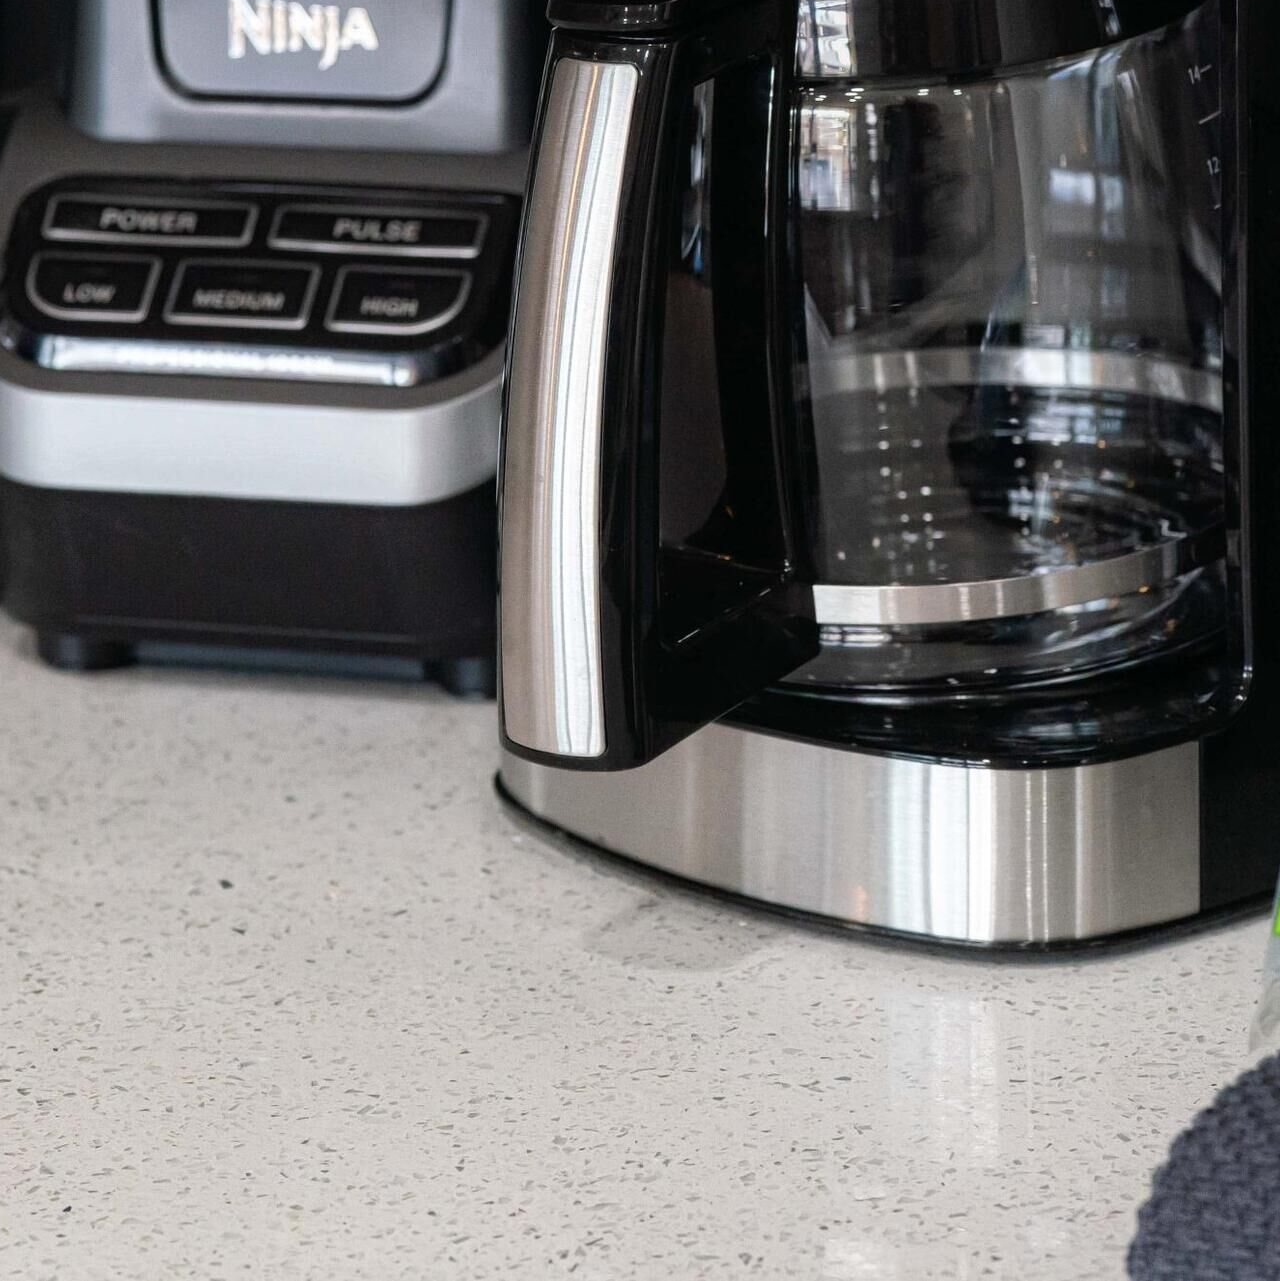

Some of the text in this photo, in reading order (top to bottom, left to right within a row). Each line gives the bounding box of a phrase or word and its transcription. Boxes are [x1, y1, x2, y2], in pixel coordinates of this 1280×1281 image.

[1188, 64, 1201, 85] 14
[99, 207, 198, 234] POWER
[333, 219, 421, 242] PULSE
[63, 283, 116, 305] LOW
[193, 289, 285, 312] MEDIUM
[360, 296, 419, 318] HIGH
